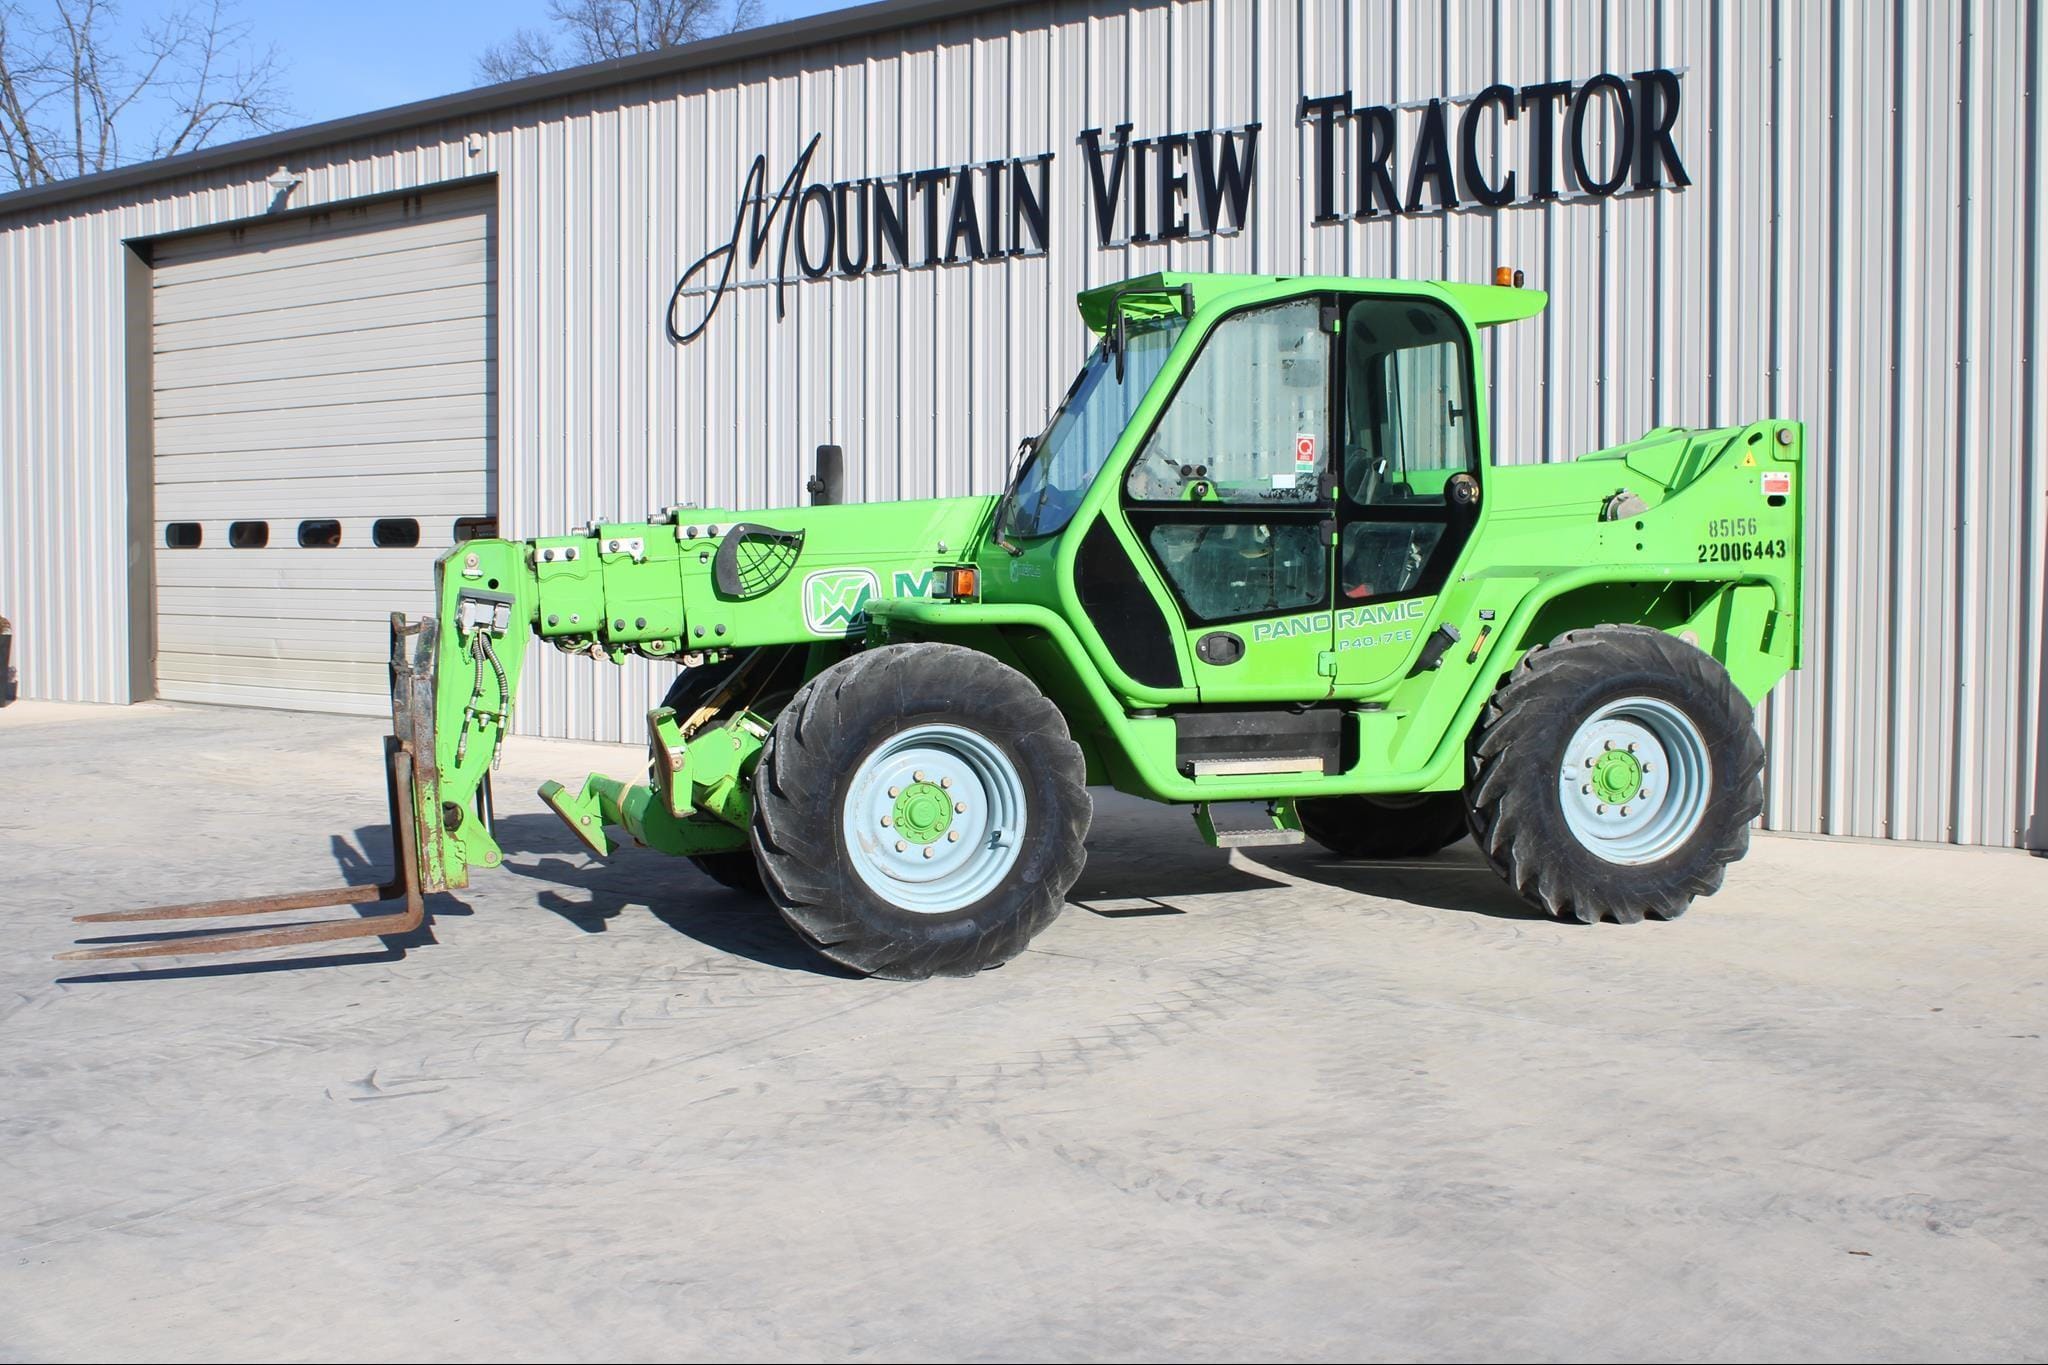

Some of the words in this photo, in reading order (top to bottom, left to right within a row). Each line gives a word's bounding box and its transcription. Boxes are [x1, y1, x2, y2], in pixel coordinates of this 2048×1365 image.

[667, 131, 1055, 343] MOUNTAIN
[1080, 122, 1262, 246] VIEW
[1302, 68, 1692, 222] TRACTOR
[1709, 517, 1757, 538] 85156
[1697, 539, 1786, 563] 22006443
[1253, 600, 1424, 642] PANORAMIC
